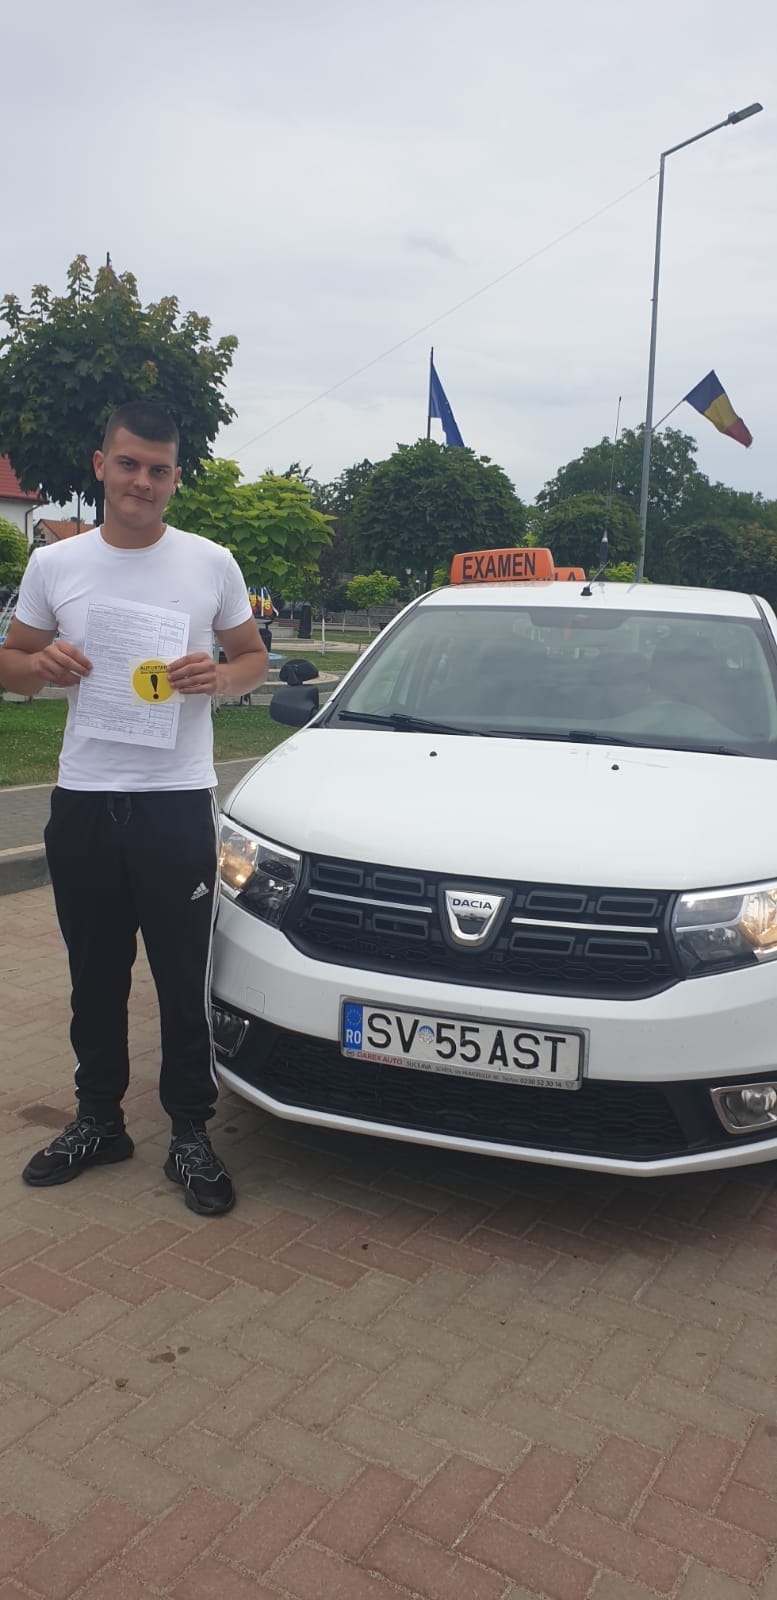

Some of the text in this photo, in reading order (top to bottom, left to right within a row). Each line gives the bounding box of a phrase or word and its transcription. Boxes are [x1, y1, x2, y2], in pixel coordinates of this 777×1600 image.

[463, 552, 536, 580] EXAMEN
[452, 898, 492, 910] DACIA
[346, 1029, 362, 1045] RO
[367, 1013, 567, 1073] SV 55 AST
[382, 1056, 403, 1065] AUTO
